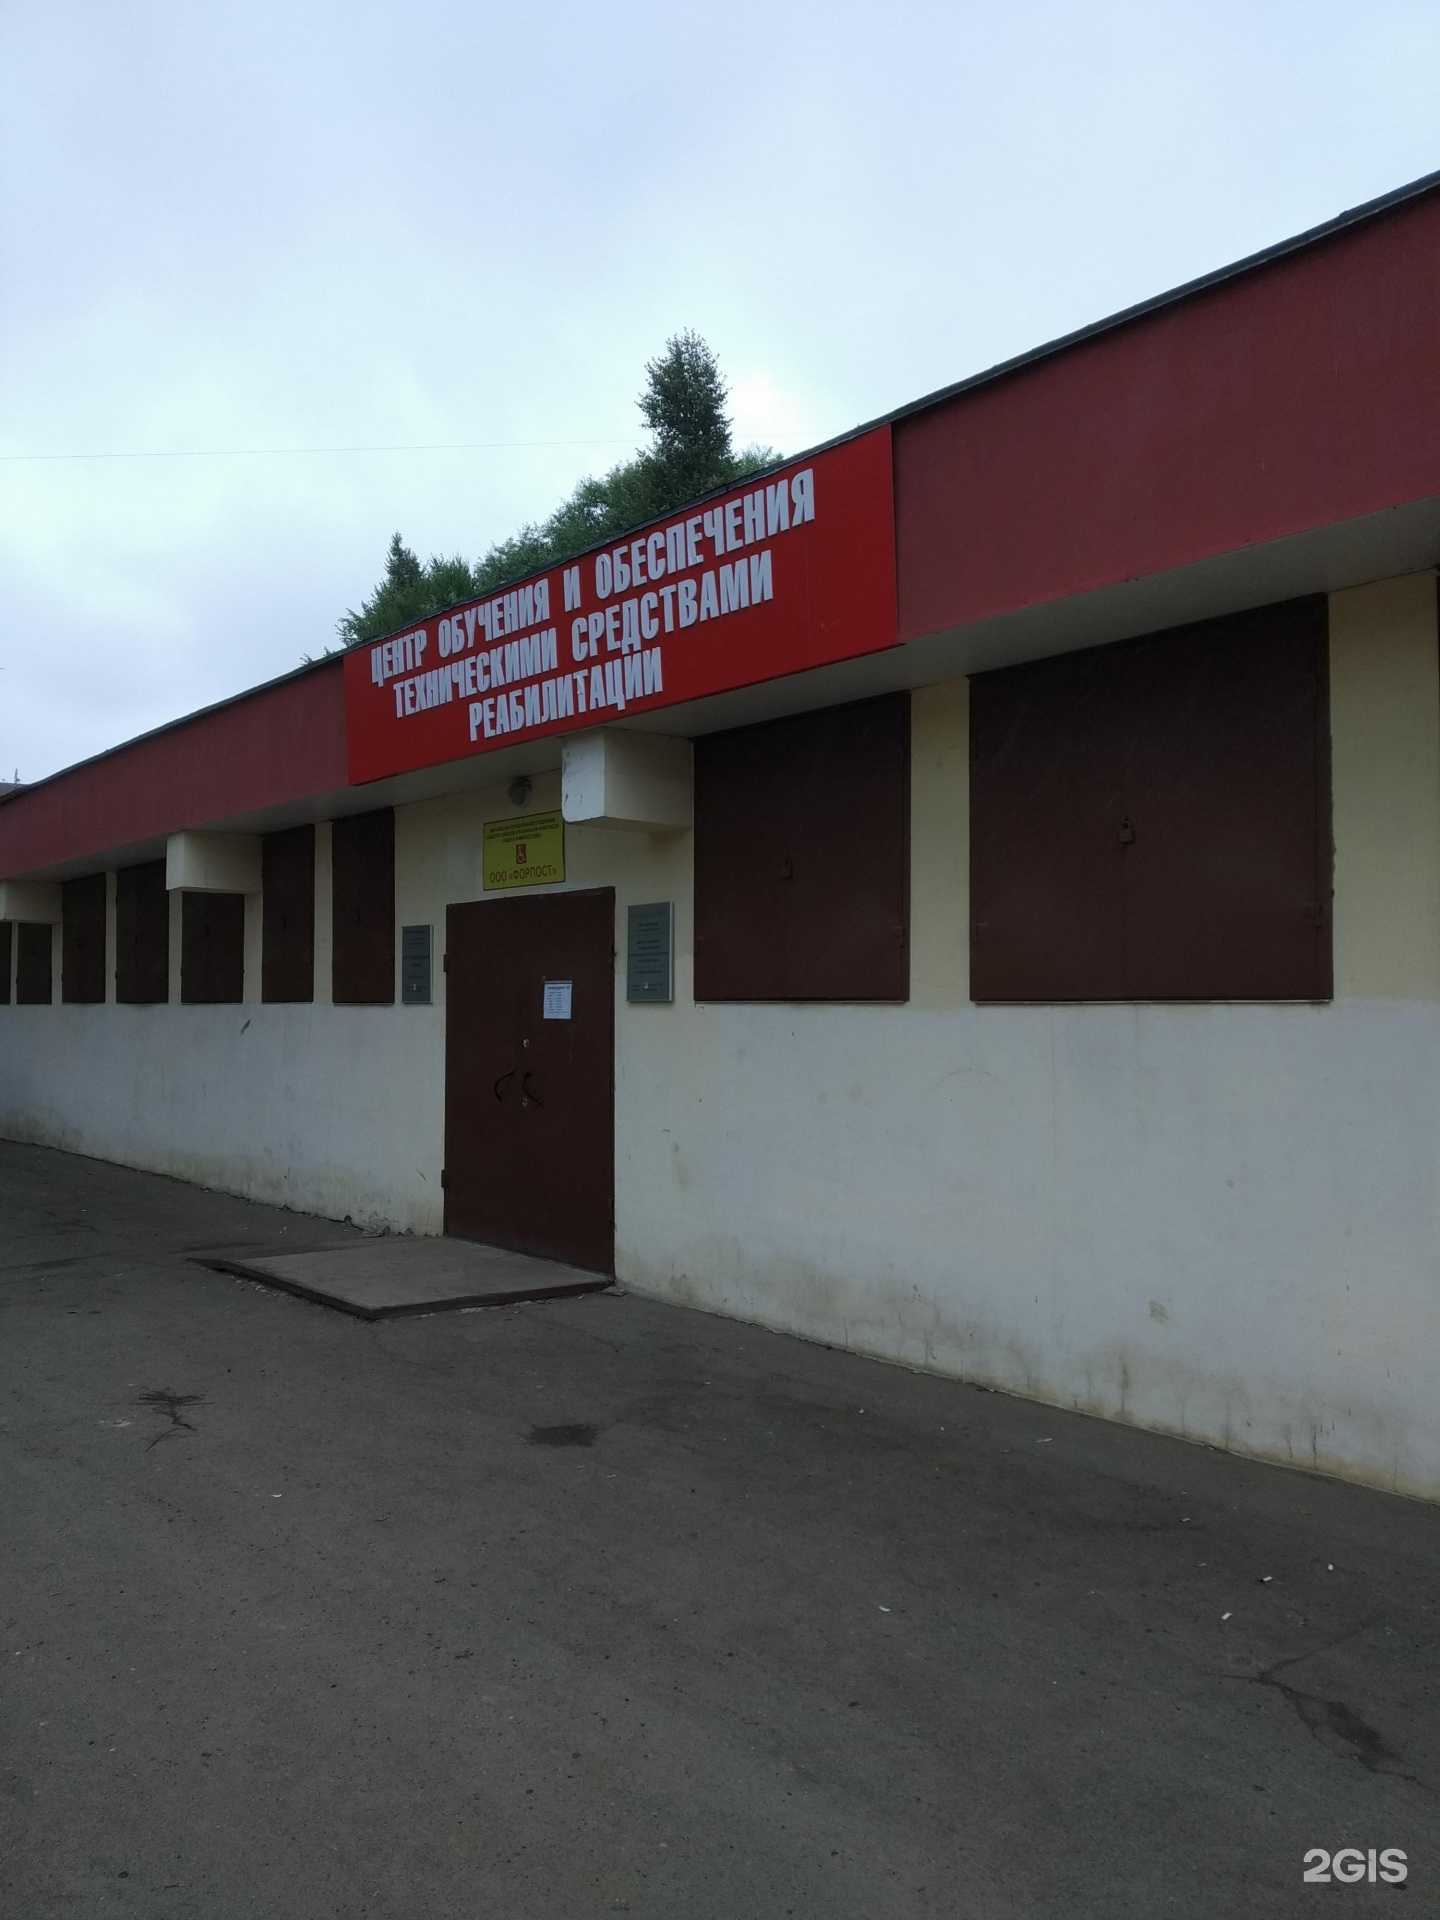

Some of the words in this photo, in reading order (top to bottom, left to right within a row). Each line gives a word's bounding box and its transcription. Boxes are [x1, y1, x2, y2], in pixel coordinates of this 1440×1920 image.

[371, 629, 427, 687] ЦЕНТР
[438, 578, 550, 658] ОБУЧЕНИЯ
[563, 565, 581, 612] И
[595, 468, 815, 599] ОБЕСПЕЧЕНИЯ
[393, 627, 558, 719] ТЕХНИЧЕСКИМИ
[572, 549, 774, 662] СРЕДСТВАМИ
[469, 647, 663, 743] РЕАБИЛИТАЦИИ
